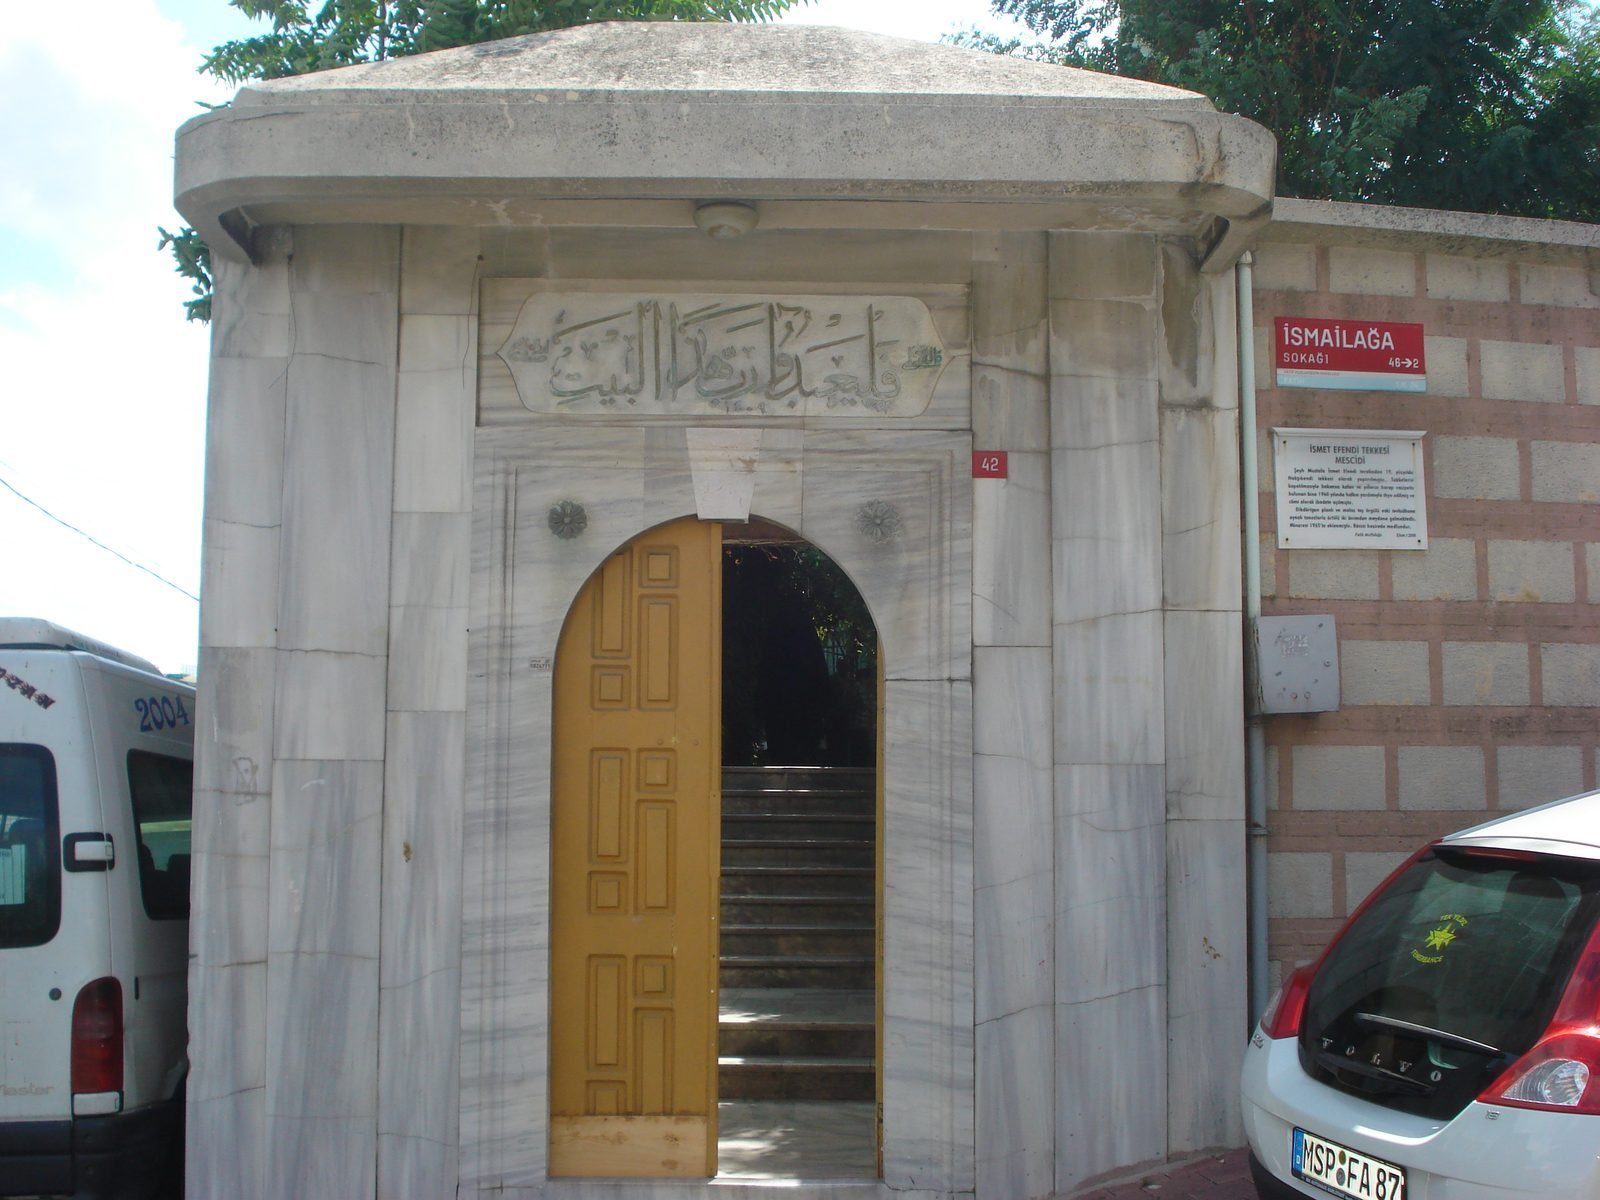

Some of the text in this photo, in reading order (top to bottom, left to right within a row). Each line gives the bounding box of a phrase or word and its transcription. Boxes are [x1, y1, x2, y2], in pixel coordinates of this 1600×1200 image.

[1283, 323, 1395, 351] İSMAİLAĞA
[1283, 352, 1329, 364] SOKAĞI
[1310, 443, 1390, 455] İSMET EFENDİ TEKKESİ
[981, 457, 999, 472] 42
[1335, 455, 1366, 465] MESCİDİ
[134, 695, 189, 733] 2004
[1321, 1037, 1443, 1083] VOLVO
[1302, 1137, 1400, 1200] MSP FA 87
